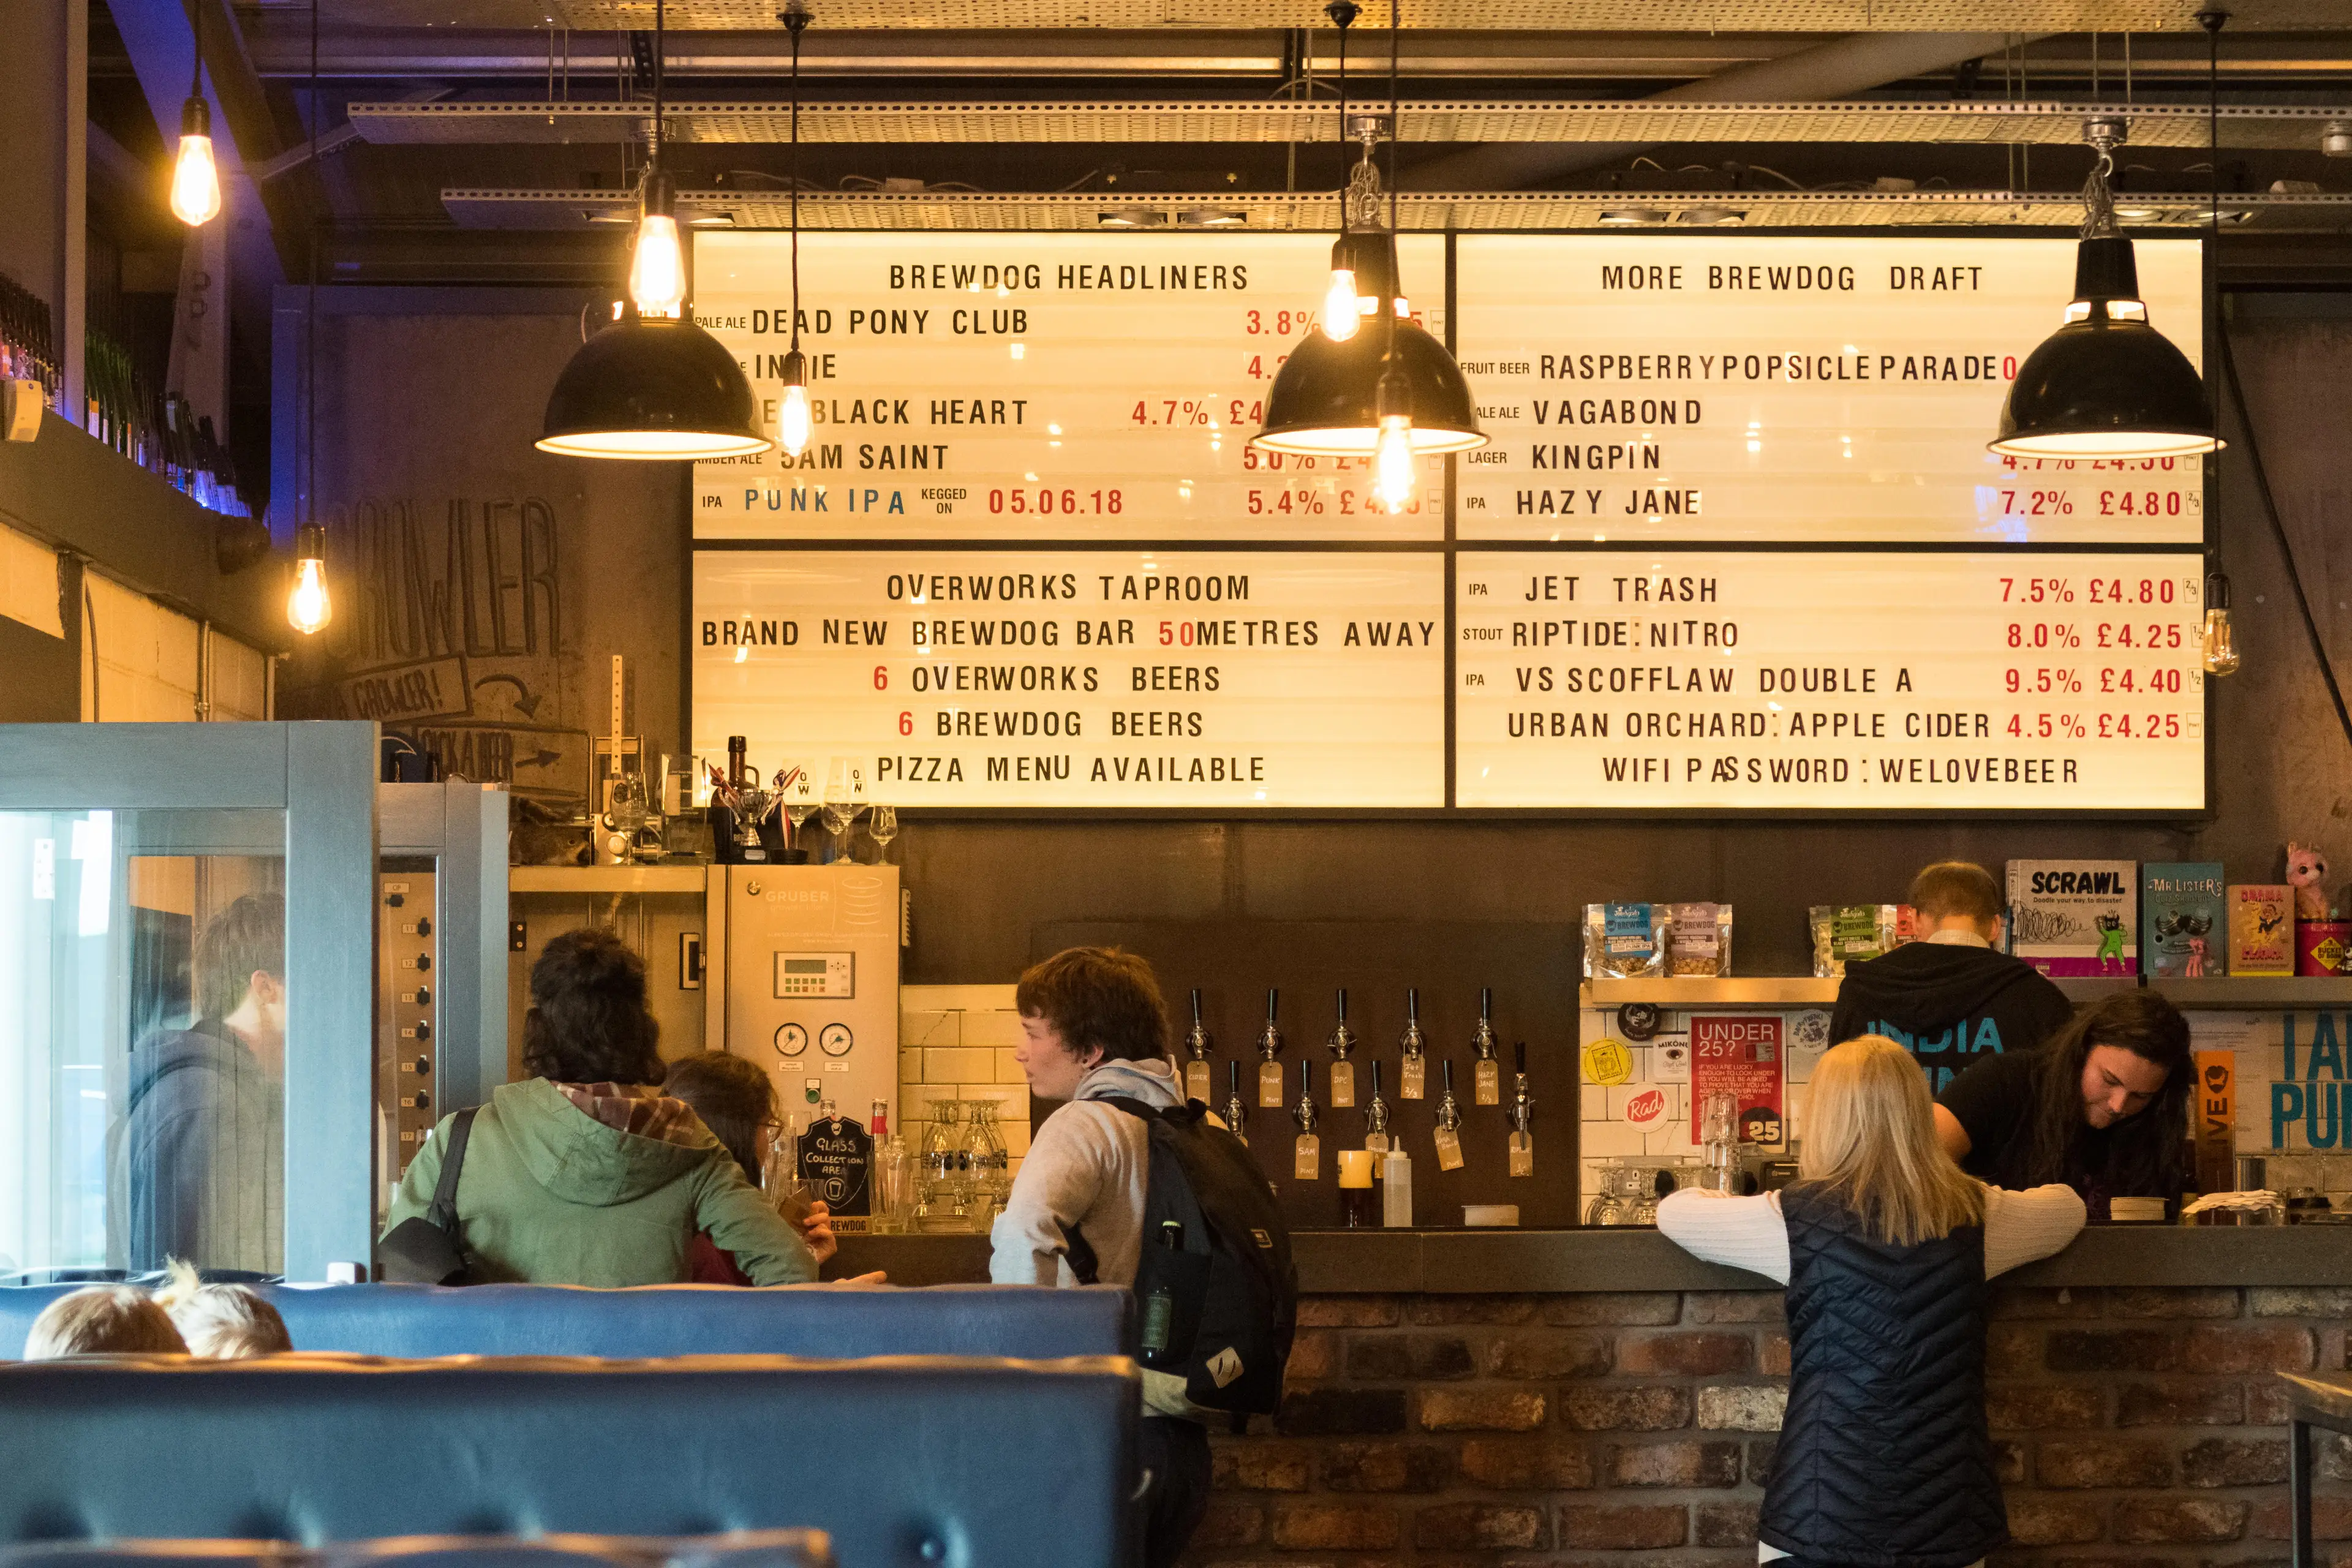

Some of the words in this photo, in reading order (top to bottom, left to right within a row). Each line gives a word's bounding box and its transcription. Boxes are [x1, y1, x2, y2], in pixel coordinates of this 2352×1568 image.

[890, 264, 1041, 290] BREWDOG
[1058, 265, 1247, 290] HEADLINERS
[1602, 265, 1683, 290] MORE
[1709, 266, 1854, 291] BREWDOG
[1891, 266, 1983, 290] DRAFT
[695, 317, 722, 328] PALE
[725, 317, 746, 328] ALE
[753, 309, 832, 334] DEAD
[850, 309, 929, 334] PONY
[952, 309, 1028, 334] CLUB
[1246, 310, 1321, 335] 3.8%
[755, 354, 837, 379] INIE
[1460, 362, 1495, 374] FRUIT
[1499, 362, 1530, 374] BEER
[812, 399, 910, 424] BLACK
[931, 399, 1027, 424] HEART
[1132, 401, 1208, 425] 4.7%
[1476, 407, 1496, 418] ALE
[1499, 407, 1520, 418] ALE
[1532, 399, 1702, 424] VAGABOND
[859, 444, 949, 470] SAINT
[1468, 451, 1507, 464] LAGER
[1532, 445, 1660, 470] KINGPIN
[703, 496, 723, 508] IPA
[745, 488, 829, 512] PUNK
[849, 489, 905, 514] IPA
[921, 488, 967, 500] KEGGED
[989, 489, 1122, 514] 05.06.18
[1248, 490, 1324, 515] 5.4%
[1466, 497, 1486, 509] IPA
[1517, 489, 1602, 515] HAZY
[1625, 489, 1699, 515] JANE
[2001, 491, 2073, 515] 7.2%
[2100, 491, 2180, 516] £4.80
[937, 503, 952, 514] ON
[887, 573, 1077, 601] OVERWORKS
[1099, 575, 1249, 601] TAPROOM
[1469, 584, 1488, 595] IPA
[1525, 576, 1580, 601] JET
[1613, 577, 1717, 603] TRASH
[1999, 578, 2075, 603] 7.5%
[2089, 578, 2174, 603] £4.80
[703, 620, 799, 646] BRAND
[823, 619, 888, 646] NEW
[913, 620, 1058, 646] BREWDOG
[1077, 619, 1134, 646] BAR
[1343, 622, 1435, 647] AWAY
[1463, 628, 1504, 641] STOUT
[1650, 620, 1738, 647] NITRO
[2007, 623, 2081, 648] 8.0%
[2097, 623, 2182, 649] £4.25
[873, 665, 888, 691] 6
[912, 665, 1099, 692] OVERWORKS
[1132, 666, 1220, 692] BEERS
[1466, 674, 1485, 686] IPA
[1516, 666, 1554, 692] VS
[1567, 666, 1733, 693] SCOFFLAW
[1760, 668, 1876, 693] DOUBLE
[1896, 668, 1913, 693] A
[2005, 668, 2082, 693] 9.5%
[2100, 668, 2181, 693] £4.40
[899, 711, 913, 736] 6
[937, 711, 1082, 737] BREWDOG
[1112, 711, 1203, 737] BEERS
[1509, 712, 1608, 737] URBAN
[1789, 712, 1886, 738] APPLE
[1905, 712, 1989, 738] CIDER
[2007, 714, 2086, 739] 4.5%
[2098, 713, 2180, 739] £4.25
[878, 756, 963, 782] PIZZA
[987, 755, 1070, 782] MENU
[1090, 756, 1265, 782] AVAILABLE
[1602, 756, 1670, 783] WIFI
[1879, 757, 2078, 783] WELOVEBEER
[2031, 871, 2125, 895] SCRAWL
[766, 891, 829, 902] GRUBER
[1684, 920, 1716, 930] BREWDOG
[1698, 1023, 1774, 1041] UNDER
[1698, 1041, 1736, 1057] 25?
[1333, 1076, 1348, 1084] DPC
[1629, 1091, 1663, 1120] Rad
[2271, 1083, 2352, 1149] PU
[1749, 1121, 1780, 1142] 25
[816, 1137, 856, 1153] GLASS
[805, 1152, 864, 1164] COLLECTION
[831, 1219, 867, 1231] REWDOG
